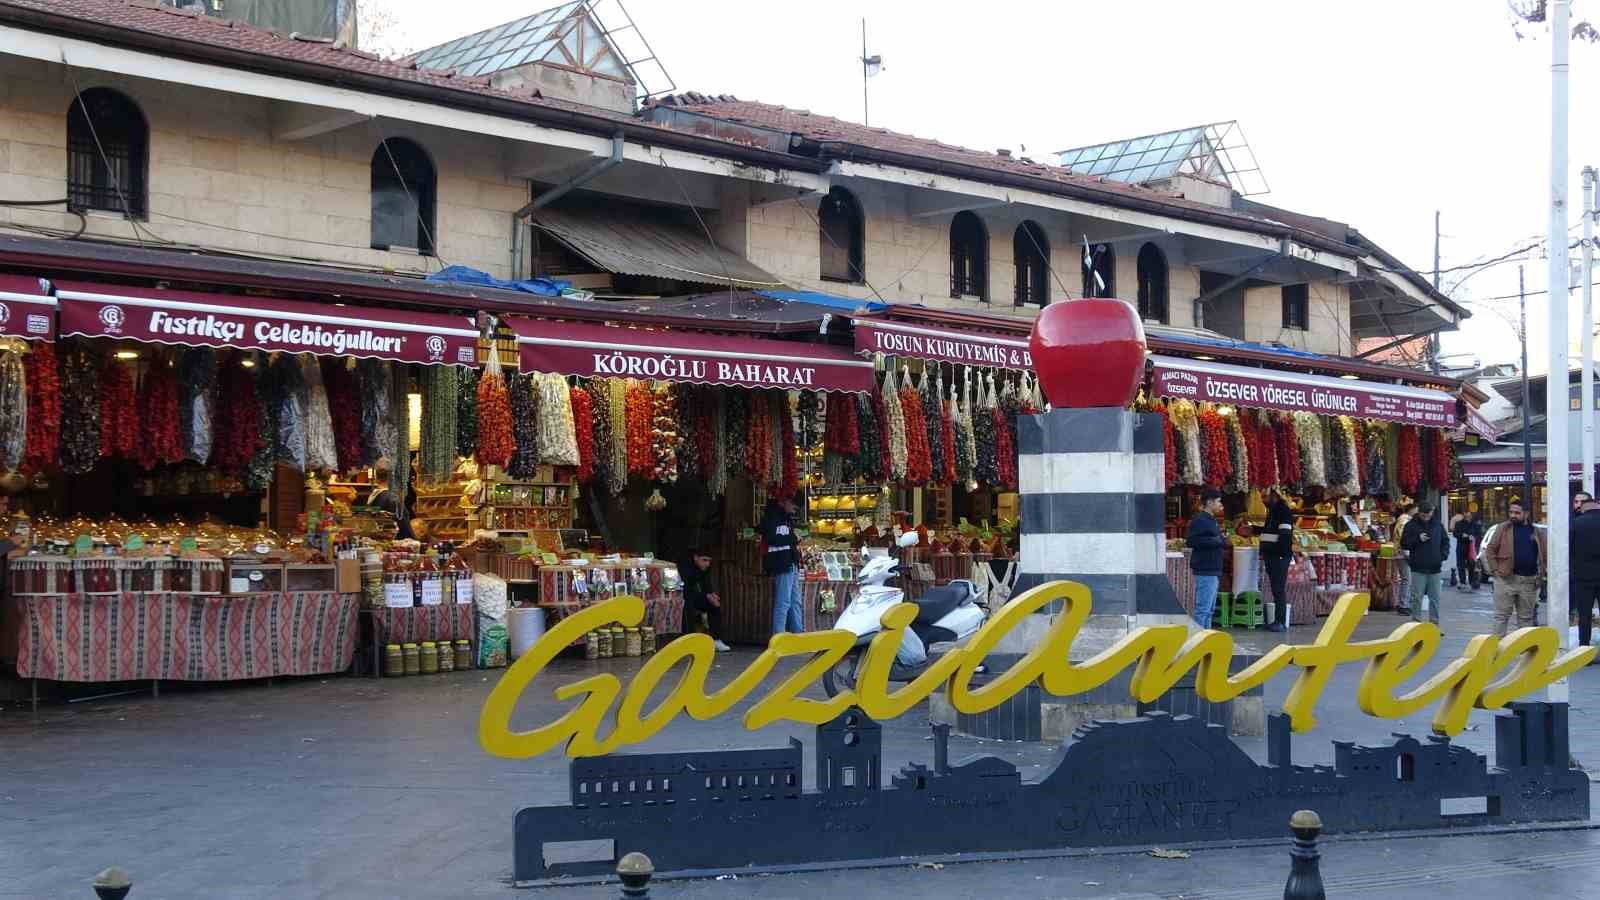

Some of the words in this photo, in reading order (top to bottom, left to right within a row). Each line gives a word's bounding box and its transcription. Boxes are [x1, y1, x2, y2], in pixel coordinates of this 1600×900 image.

[149, 311, 245, 341] Fıstıkçı
[254, 321, 401, 353] Çelebioğulları
[873, 331, 925, 354] TOSUN
[926, 335, 1007, 369] KURUYEMİŞ
[1009, 349, 1021, 366] &
[593, 351, 707, 380] KÖROĞLU
[717, 361, 816, 385] BAHARAT
[1167, 382, 1197, 395] ÖZSEVER
[1206, 376, 1259, 402] ÖZSEVER
[1261, 383, 1309, 407] YÖRESEL
[1311, 388, 1358, 412] ÜRÜNLER
